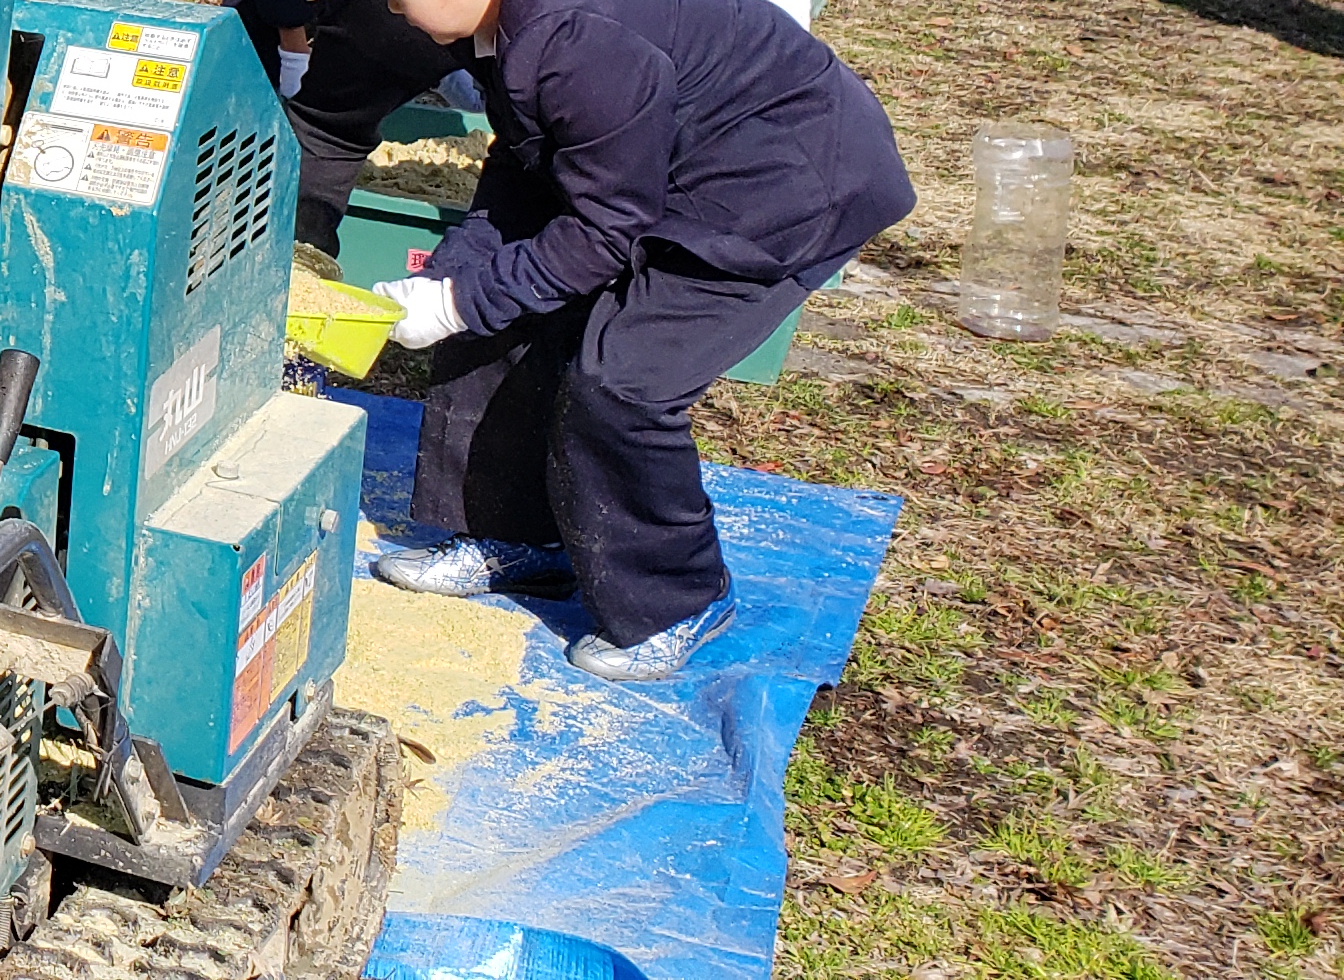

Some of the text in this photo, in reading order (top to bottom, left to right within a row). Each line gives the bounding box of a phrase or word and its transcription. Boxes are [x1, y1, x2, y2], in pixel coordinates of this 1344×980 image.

[153, 64, 180, 79] 注意
[116, 129, 154, 148] 警告
[158, 363, 206, 442] 丸山
